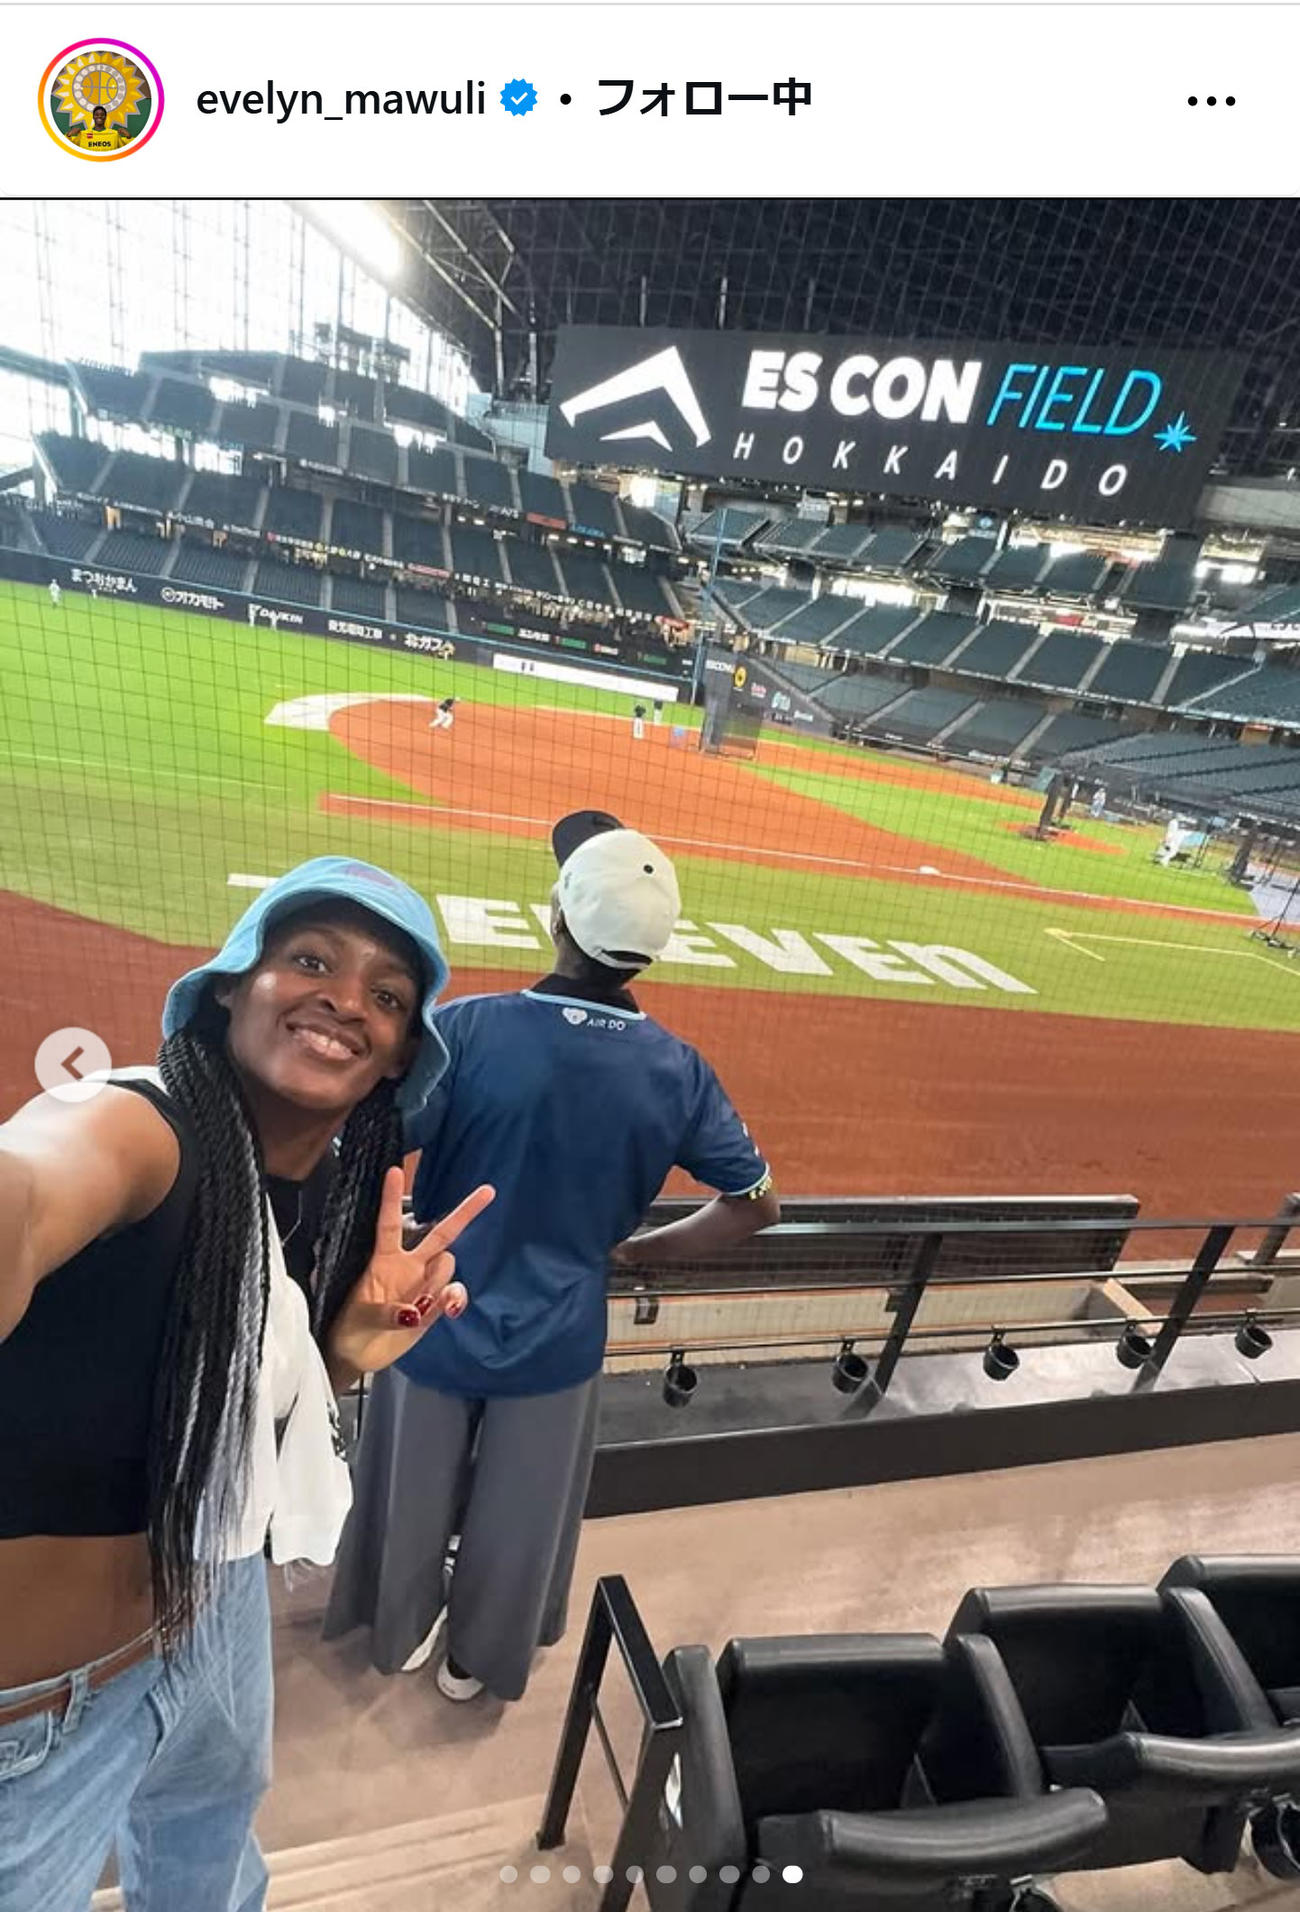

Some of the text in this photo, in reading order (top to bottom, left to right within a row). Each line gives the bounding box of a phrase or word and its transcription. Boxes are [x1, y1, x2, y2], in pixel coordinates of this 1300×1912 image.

[741, 350, 1163, 437] ES CON FIELD
[733, 432, 1128, 496] HOKKAIDO
[587, 1018, 626, 1031] AIR DO
